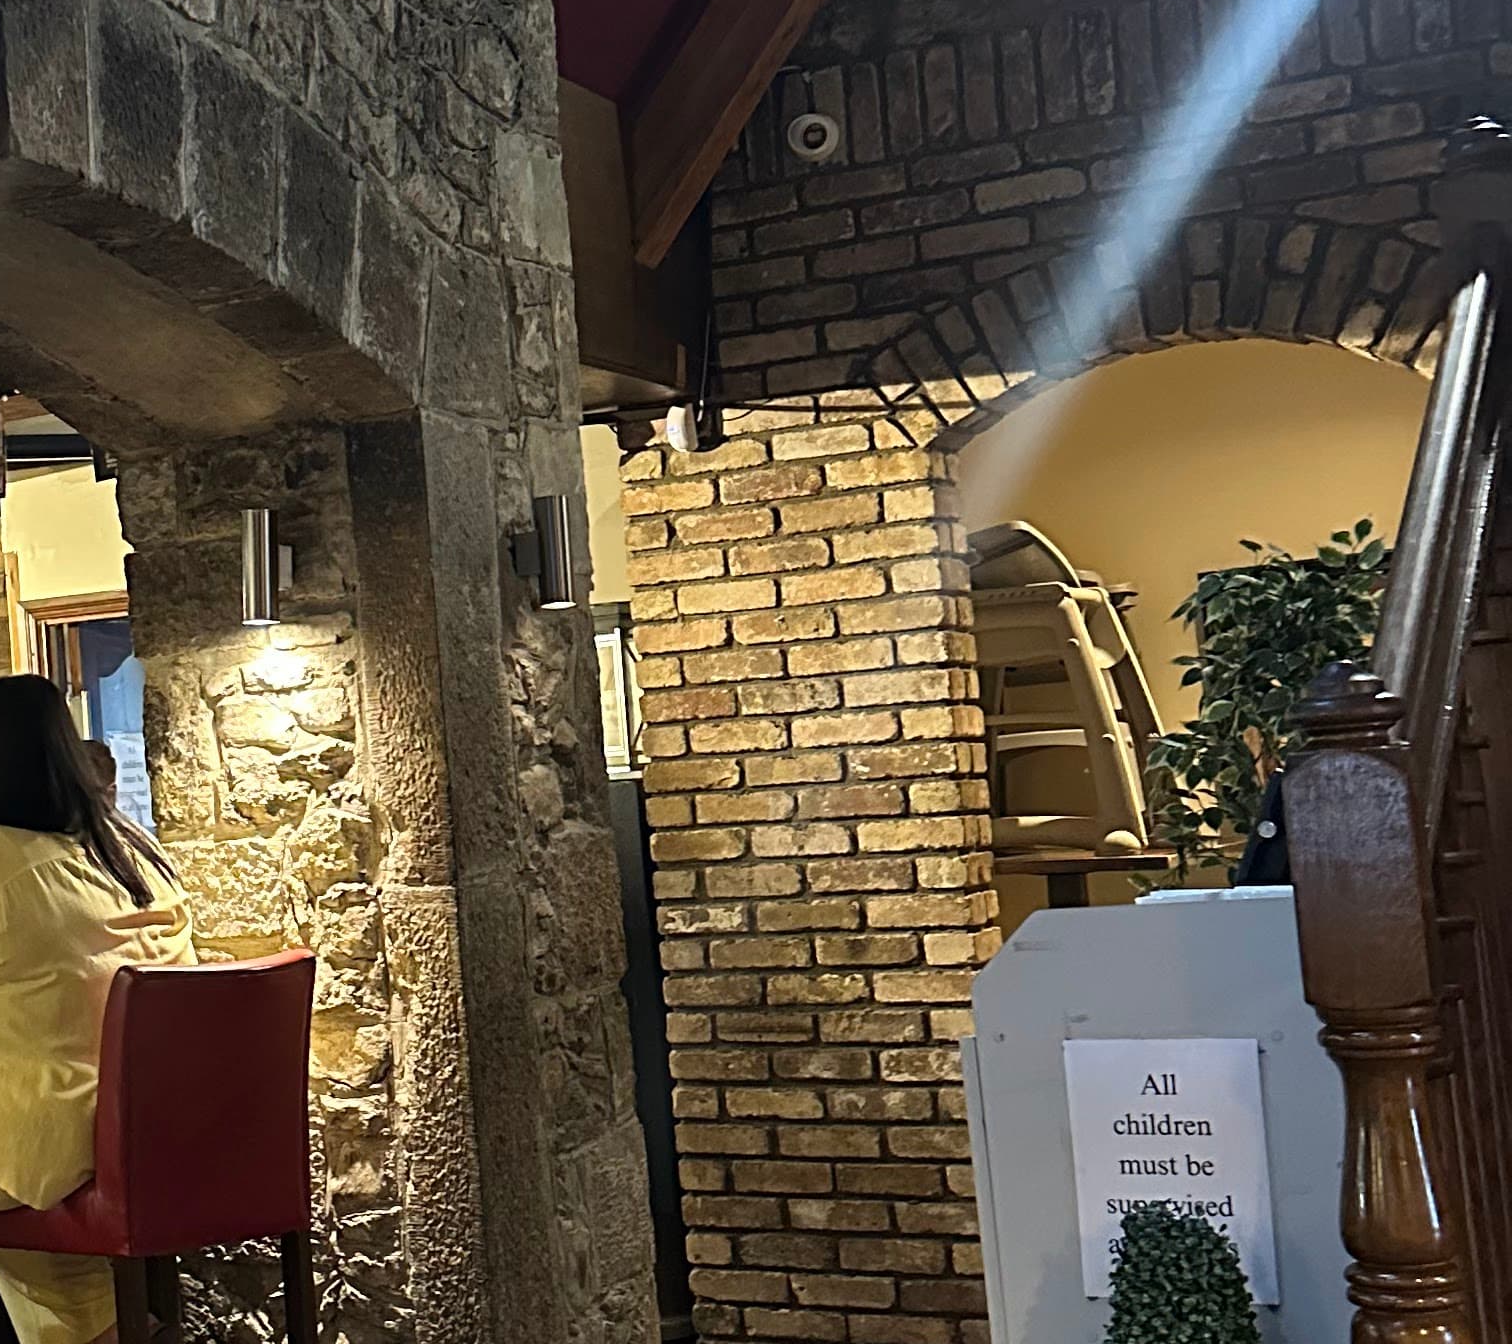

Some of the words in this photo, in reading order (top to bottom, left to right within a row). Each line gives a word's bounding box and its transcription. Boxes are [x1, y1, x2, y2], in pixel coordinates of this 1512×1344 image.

[1141, 1073, 1177, 1096] All
[1113, 1113, 1213, 1137] children
[1119, 1157, 1178, 1176] must
[1185, 1155, 1215, 1177] be
[1106, 1194, 1234, 1217] suvied
